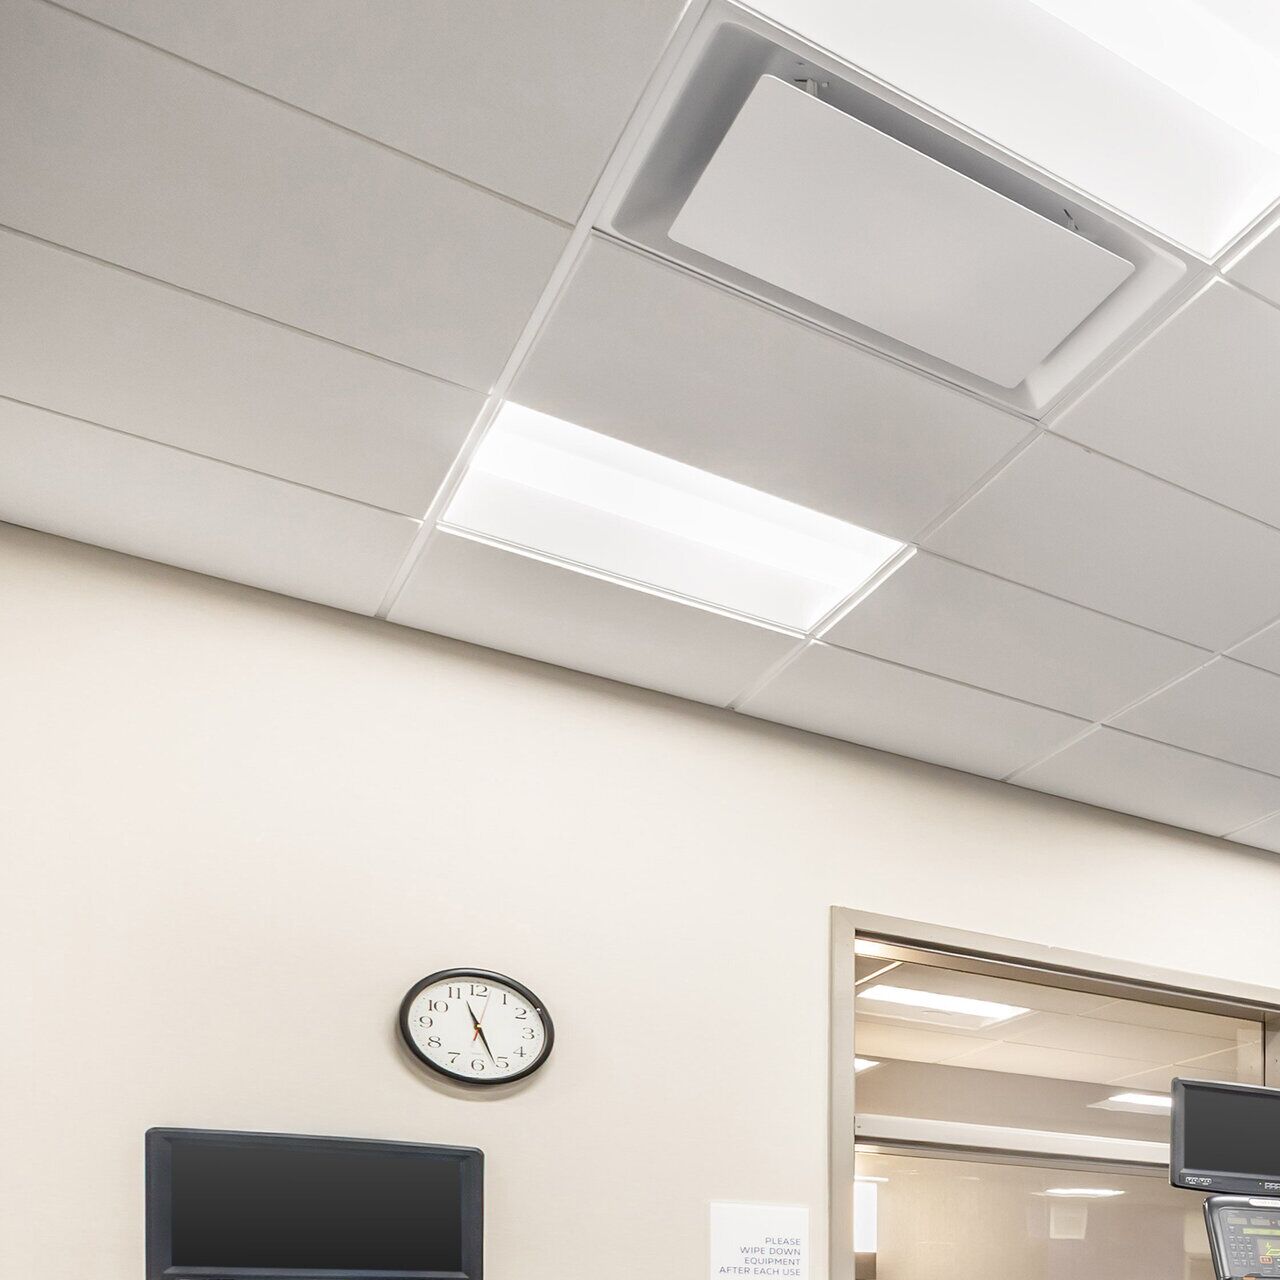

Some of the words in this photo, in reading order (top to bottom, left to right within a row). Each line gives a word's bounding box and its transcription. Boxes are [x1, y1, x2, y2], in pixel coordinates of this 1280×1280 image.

[448, 986, 461, 999] 11
[470, 984, 488, 997] 12
[502, 993, 507, 1005] 1
[428, 999, 449, 1013] 10
[515, 1007, 527, 1020] 2
[419, 1015, 433, 1028] 9
[522, 1027, 535, 1040] 3
[427, 1035, 442, 1049] 8
[447, 1051, 461, 1064] 7
[513, 1046, 527, 1058] 4
[471, 1059, 485, 1072] 6
[496, 1056, 509, 1069] 5
[765, 1237, 801, 1246] PLEASE
[740, 1246, 766, 1255] WIPE
[769, 1247, 801, 1256] DOWN
[744, 1257, 801, 1266] EQUIPMENT
[719, 1266, 751, 1275] AFTER
[753, 1267, 780, 1276] EACH
[782, 1268, 801, 1277] USE
